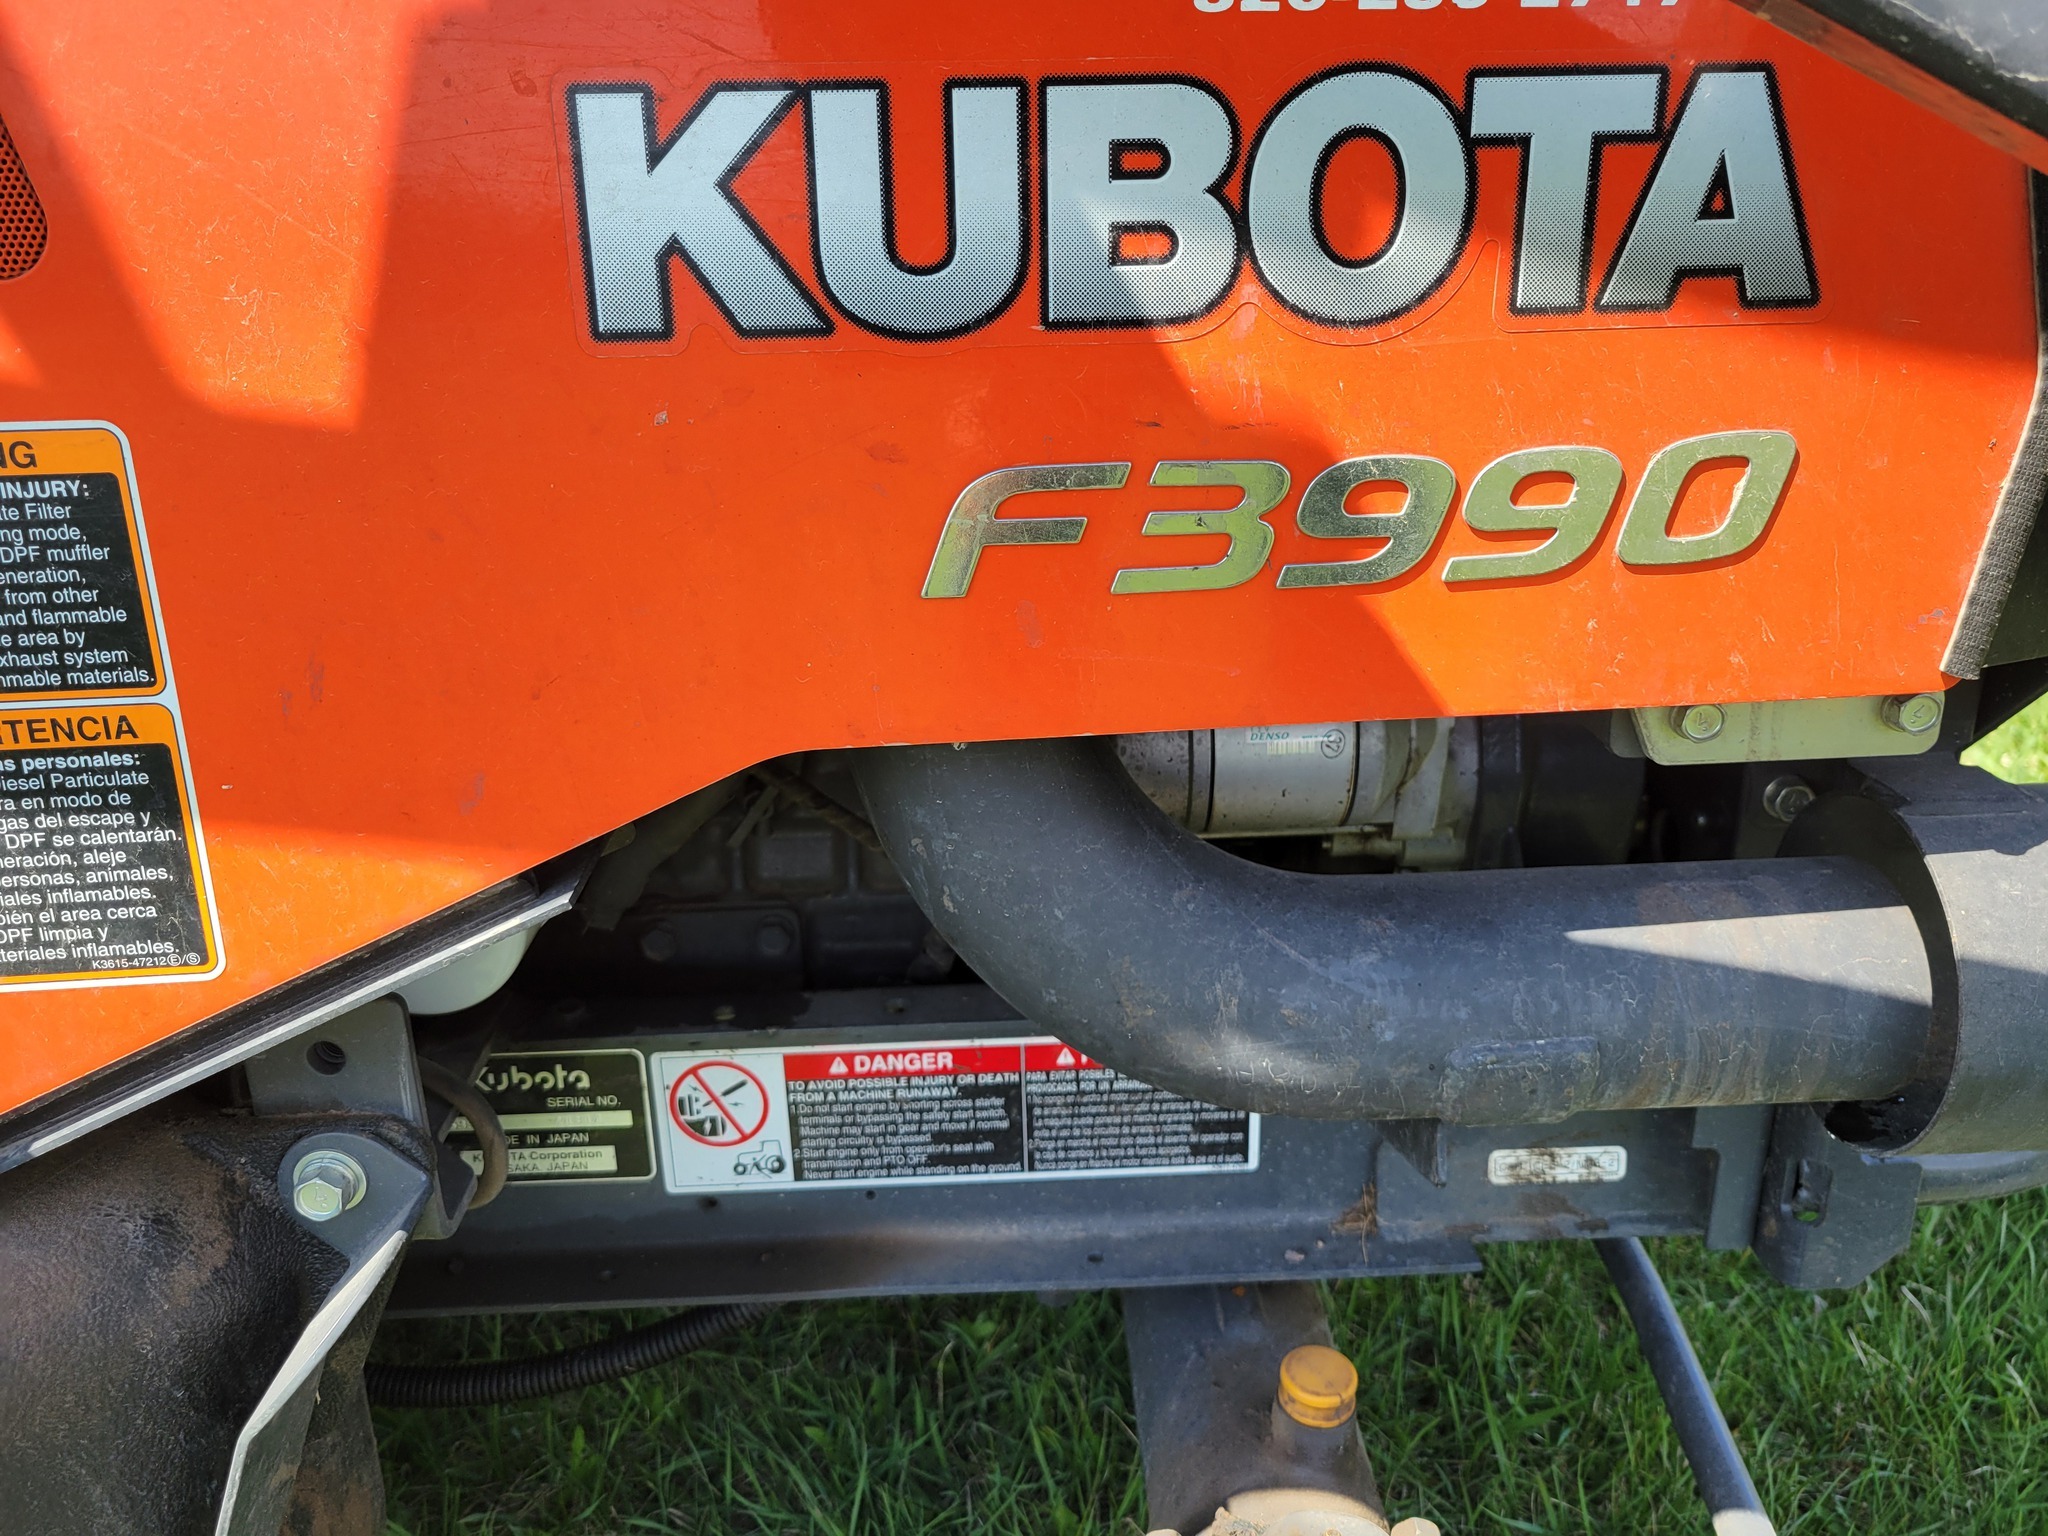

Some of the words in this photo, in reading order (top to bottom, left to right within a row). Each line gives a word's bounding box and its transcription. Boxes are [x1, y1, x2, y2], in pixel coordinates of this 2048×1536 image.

[570, 61, 1820, 342] KUBOTA
[0, 480, 88, 499] INJURY:
[0, 505, 19, 521] te
[25, 503, 72, 520] Filter
[920, 430, 1797, 599] F3990
[29, 524, 87, 542] mode,
[0, 546, 40, 564] DPF
[47, 545, 110, 561] muffler
[5, 589, 47, 605] from
[52, 587, 99, 603] other
[32, 606, 127, 625] flammable
[18, 631, 59, 645] area
[64, 629, 85, 647] by
[64, 648, 128, 668] system
[67, 667, 155, 685] materials.
[0, 714, 139, 744] TENCIA
[1250, 732, 1290, 741] DENSO
[22, 751, 140, 774] personales:
[0, 774, 45, 791] iesel
[51, 771, 149, 789] Particulate
[21, 796, 44, 809] en
[50, 791, 102, 808] modo
[108, 790, 131, 805] de
[35, 812, 62, 828] del
[68, 812, 135, 829] escape
[140, 812, 151, 826] y
[5, 832, 46, 849] DPF
[52, 834, 74, 846] se
[80, 827, 182, 846] calentarán.
[83, 849, 127, 867] aleje
[0, 873, 80, 888] ersonas,
[86, 866, 173, 883] animales,
[47, 886, 156, 904] inflamables.
[39, 907, 56, 922] el
[61, 908, 102, 922] area
[107, 905, 157, 919] cerca
[39, 926, 93, 944] limpia
[98, 926, 109, 941] y
[72, 939, 180, 958] inflamables.
[854, 1052, 953, 1073] DANGER
[788, 1081, 805, 1092] TO
[807, 1079, 845, 1091] AVOID
[847, 1077, 908, 1089] POSSIBLE
[910, 1075, 954, 1086] INJURY
[957, 1074, 975, 1085] OR
[978, 1072, 1019, 1084] DEATH
[546, 1096, 595, 1107] SERIAL
[597, 1095, 621, 1106] NO.
[790, 1092, 824, 1103] FROM
[826, 1091, 836, 1101] A
[838, 1089, 894, 1101] MACHINE
[896, 1087, 961, 1099] RUNAWAY.
[815, 1103, 830, 1112] not
[831, 1102, 853, 1112] start
[855, 1102, 886, 1113] engine
[889, 1101, 900, 1112] by
[941, 1099, 973, 1109] across
[975, 1097, 1005, 1107] starter
[799, 1114, 842, 1125] terminals
[844, 1115, 854, 1123] or
[855, 1112, 903, 1124] bypassing
[905, 1111, 920, 1120] the
[922, 1110, 950, 1121] safety
[952, 1109, 973, 1118] start
[801, 1126, 840, 1137] Machine
[841, 1126, 862, 1136] may
[863, 1124, 885, 1134] start
[897, 1123, 919, 1134] gear
[921, 1121, 940, 1130] and
[941, 1121, 967, 1130] move
[976, 1118, 1010, 1129] normal
[527, 1134, 540, 1144] IN
[547, 1132, 589, 1144] JAPAN
[801, 1137, 836, 1148] starting
[529, 1150, 602, 1162] Corporation
[826, 1148, 858, 1158] engine
[860, 1146, 879, 1156] only
[881, 1145, 903, 1155] from
[952, 1142, 973, 1152] seat
[975, 1141, 994, 1151] with
[507, 1163, 540, 1173] SAKA
[547, 1161, 588, 1171] JAPAN
[804, 1158, 861, 1169] transmission
[863, 1157, 881, 1166] and
[882, 1155, 905, 1165] PTO
[804, 1169, 832, 1179] Never
[833, 1168, 855, 1178] start
[856, 1168, 888, 1179] engine
[890, 1166, 914, 1176] while
[915, 1164, 955, 1175] standing
[957, 1164, 969, 1173] on
[970, 1163, 986, 1172] the
